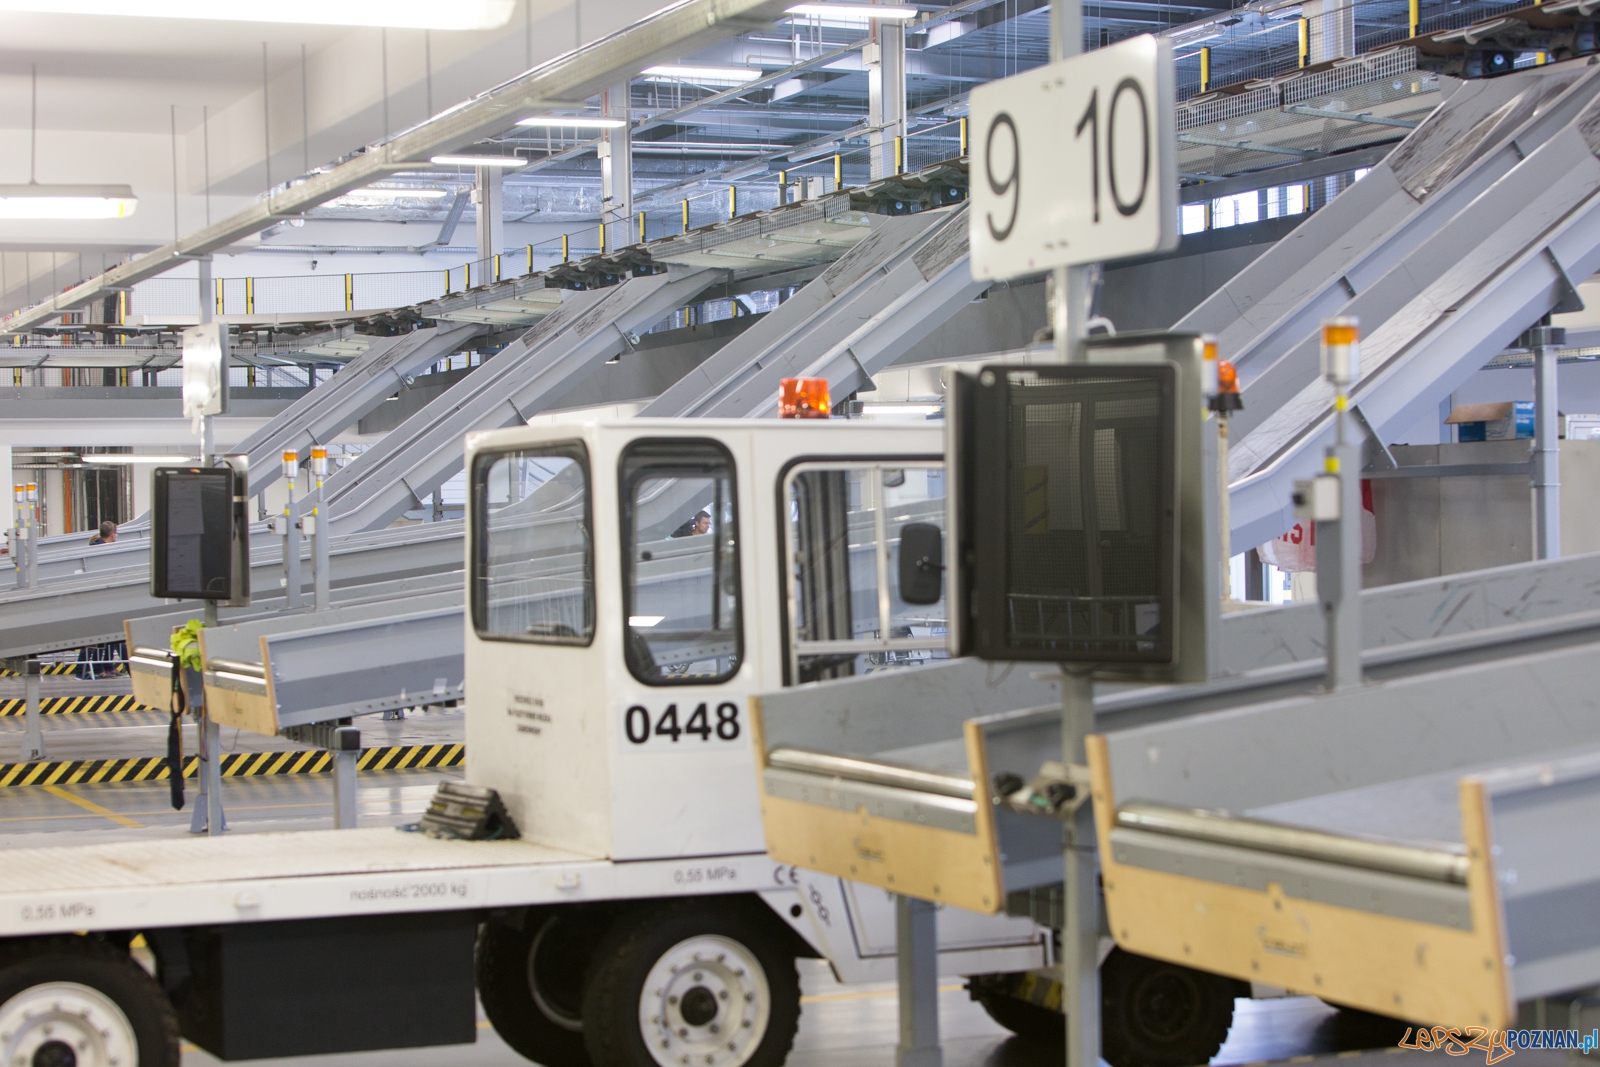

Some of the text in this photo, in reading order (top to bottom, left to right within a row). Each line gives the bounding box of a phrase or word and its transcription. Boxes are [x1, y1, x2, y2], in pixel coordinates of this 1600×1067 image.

[986, 75, 1152, 242] 9 10
[625, 701, 740, 744] 0448
[411, 882, 447, 899] 2000
[450, 881, 468, 899] kg
